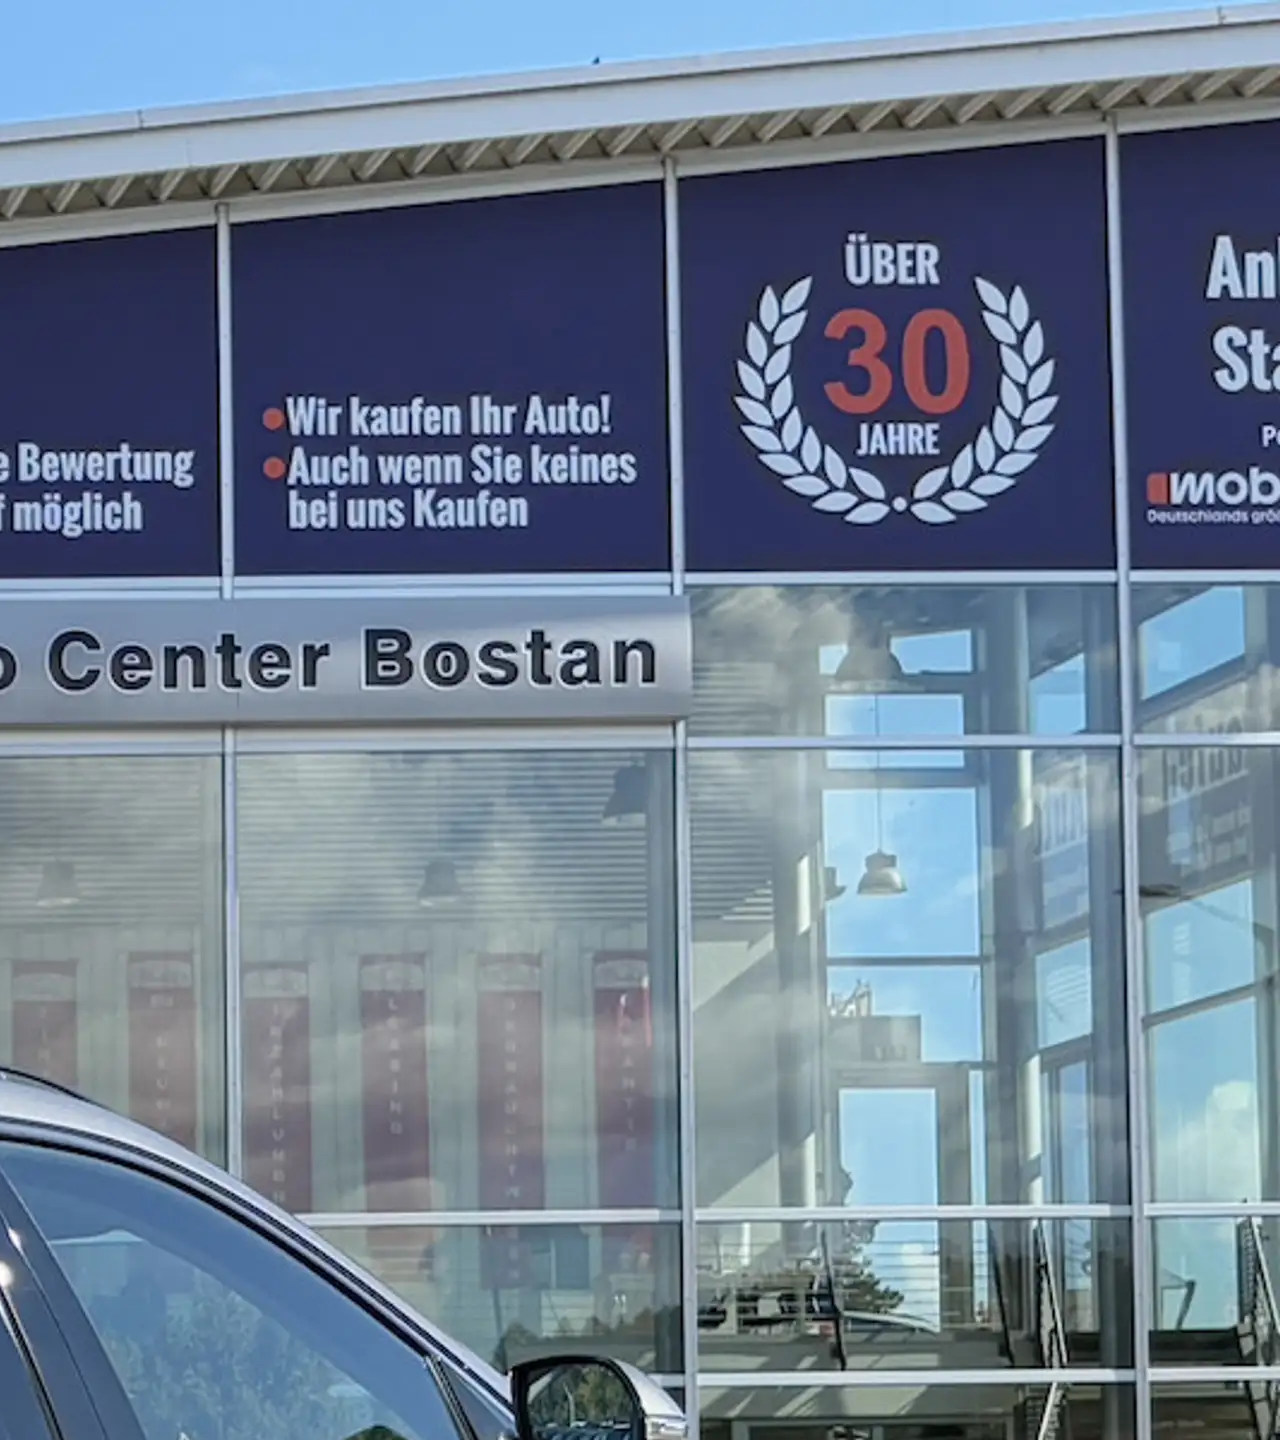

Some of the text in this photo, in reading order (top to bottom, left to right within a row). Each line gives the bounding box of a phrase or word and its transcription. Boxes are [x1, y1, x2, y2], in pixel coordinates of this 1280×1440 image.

[845, 233, 940, 285] ÜBER
[1206, 235, 1280, 299] An
[823, 308, 970, 414] 30
[286, 394, 611, 436] Wir kaufen Ihr Auto!
[856, 422, 941, 456] JAHRE
[18, 442, 196, 489] Bewertung
[287, 443, 637, 486] Auch wenn Sie keines
[13, 491, 143, 539] möglich
[289, 487, 528, 529] bei uns Kaufen
[1147, 508, 1280, 528] Deutschlands grö
[48, 630, 330, 691] Center
[364, 628, 657, 688] Bostan
